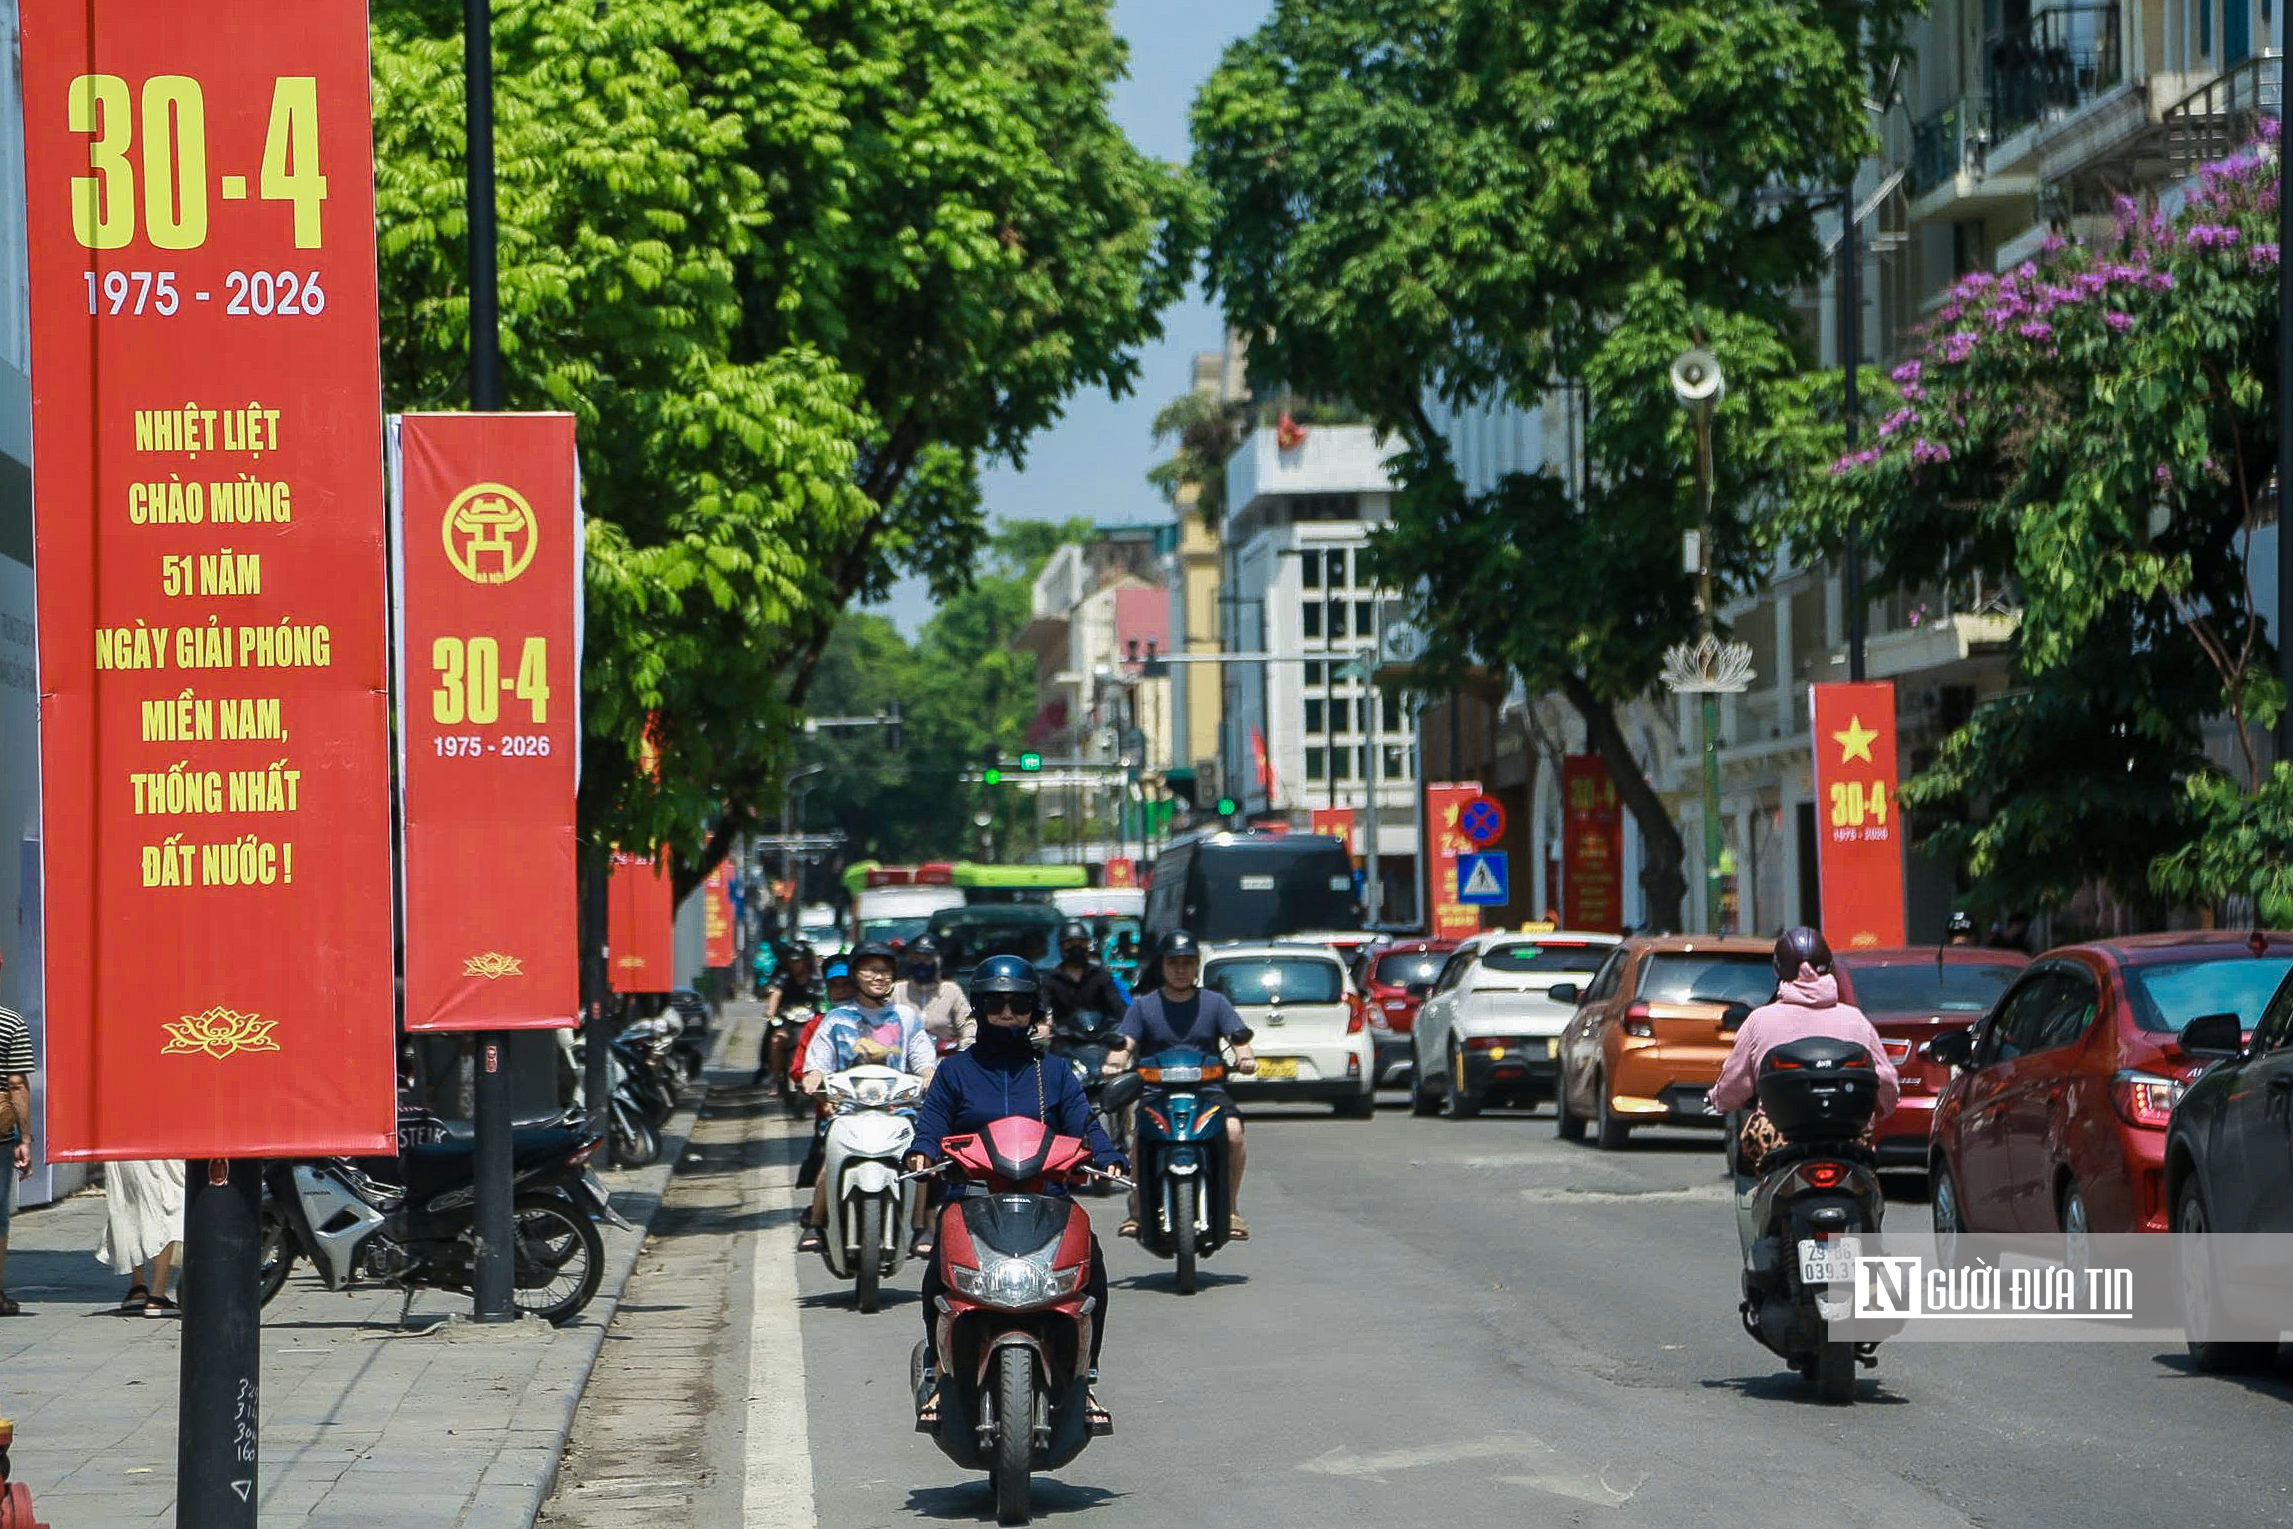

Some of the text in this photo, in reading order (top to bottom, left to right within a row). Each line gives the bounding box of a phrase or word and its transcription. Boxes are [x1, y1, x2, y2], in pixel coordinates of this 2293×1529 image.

[68, 74, 328, 250] 30-4
[83, 270, 179, 316] 1975
[225, 270, 325, 316] 2026
[134, 400, 281, 460] NHIỆT LIỆT
[128, 472, 291, 525] CHÀO MỪNG
[162, 547, 261, 597] 51 NĂM
[95, 618, 169, 670] NGÀY
[175, 614, 233, 669] GIẢI
[238, 616, 331, 668] PHÓNG
[432, 636, 551, 725] 30-4
[141, 687, 289, 744] MIỀN NAM,
[433, 735, 482, 757] 1975
[500, 735, 550, 757] 2026
[130, 759, 301, 815] THỐNG NHẤT
[1830, 780, 1888, 827] 30-4
[141, 832, 196, 888] ĐẤT
[202, 833, 277, 886] NƯỚC
